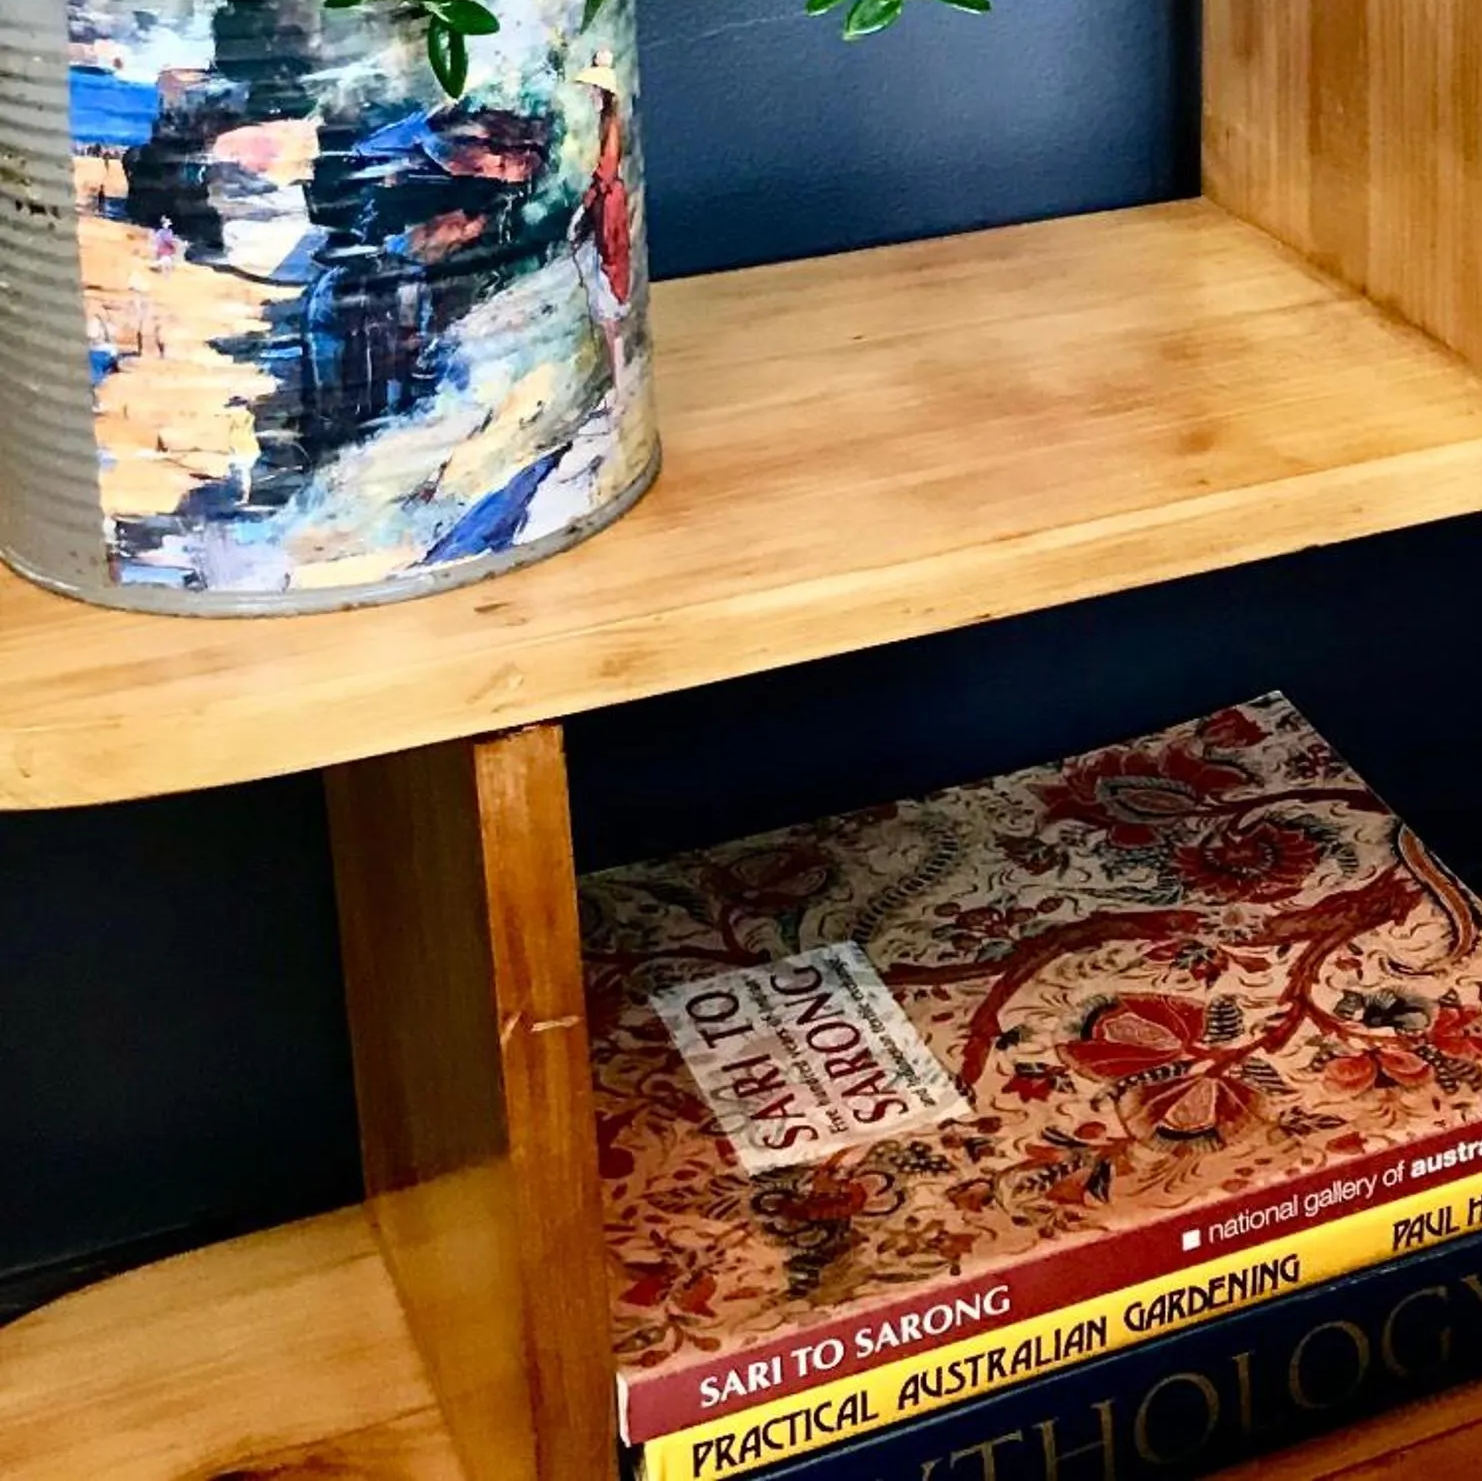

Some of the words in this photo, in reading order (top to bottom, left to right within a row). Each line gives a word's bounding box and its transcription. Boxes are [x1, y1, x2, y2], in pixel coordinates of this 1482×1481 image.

[685, 991, 754, 1049] TO
[770, 964, 909, 1123] SARONG
[776, 1028, 801, 1059] years
[721, 1054, 819, 1151] SARI
[792, 1060, 831, 1108] hundred
[911, 1087, 936, 1107] and
[825, 1108, 849, 1135] Five
[1208, 1194, 1298, 1244] national
[1303, 1173, 1378, 1217] gallery
[1382, 1159, 1406, 1188] of
[693, 1389, 879, 1478] PRACTICAL
[897, 1314, 1107, 1411] AUSTRALIAN
[1123, 1253, 1301, 1333] GARDENING
[1392, 1204, 1460, 1253] PAUL
[700, 1356, 783, 1409] SARI
[791, 1337, 845, 1378] TO
[854, 1284, 1011, 1359] SARONG
